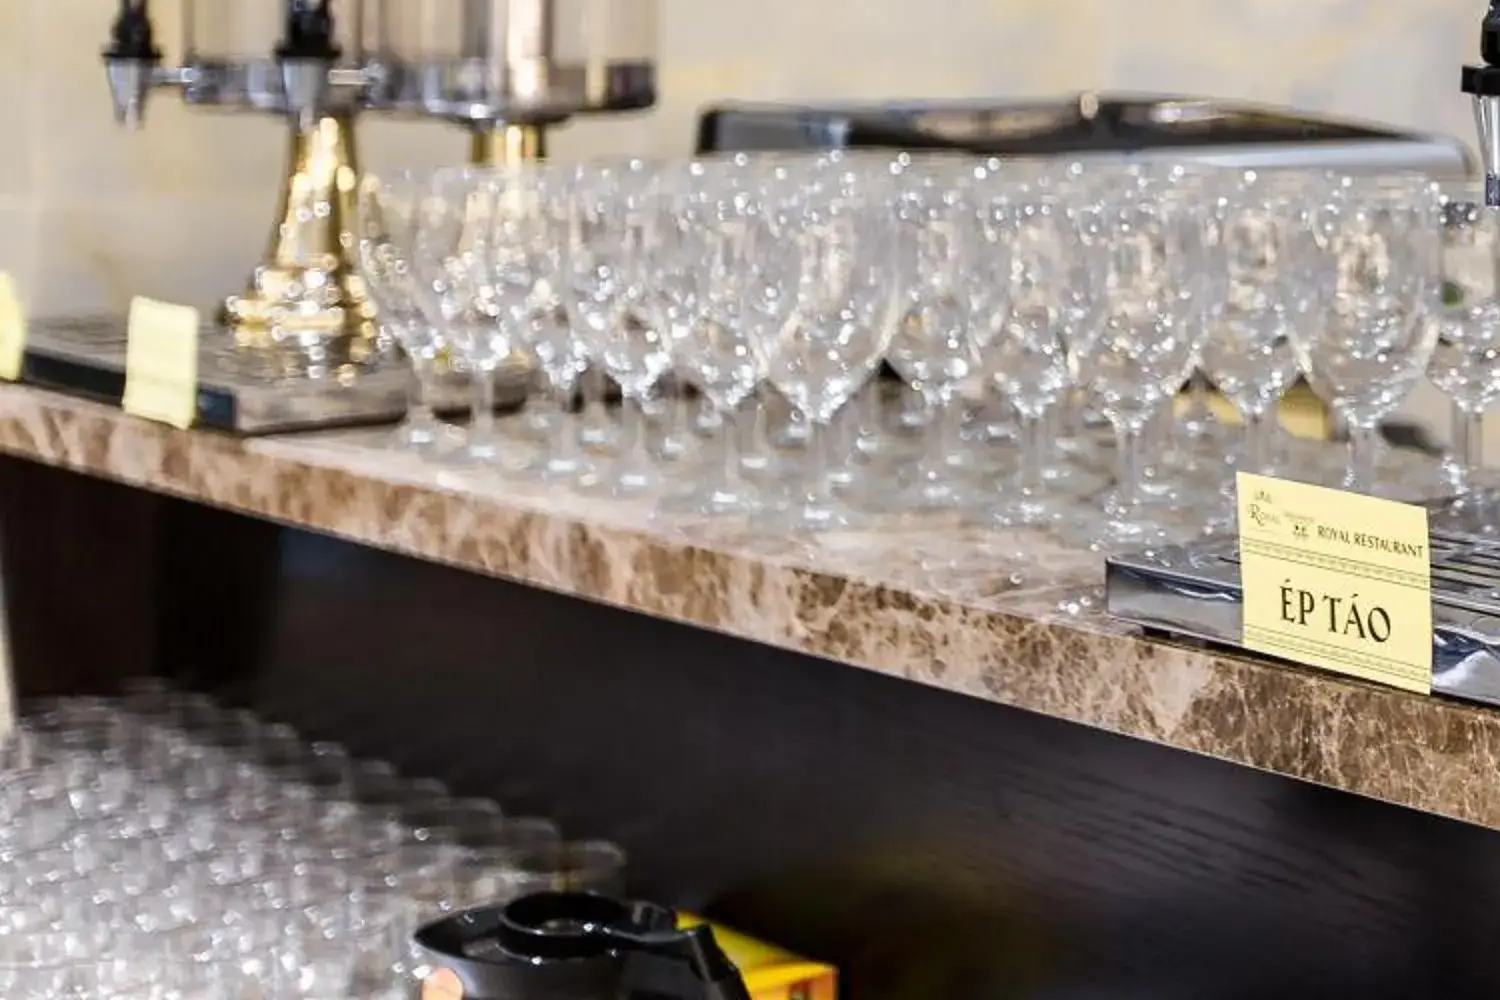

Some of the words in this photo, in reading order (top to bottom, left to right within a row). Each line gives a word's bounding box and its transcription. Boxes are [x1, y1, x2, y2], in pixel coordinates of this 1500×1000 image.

[1317, 525, 1351, 544] ROYAL
[1353, 533, 1424, 558] RESTAURANT
[1280, 578, 1316, 626] ÉP
[1322, 593, 1392, 643] TÁO
